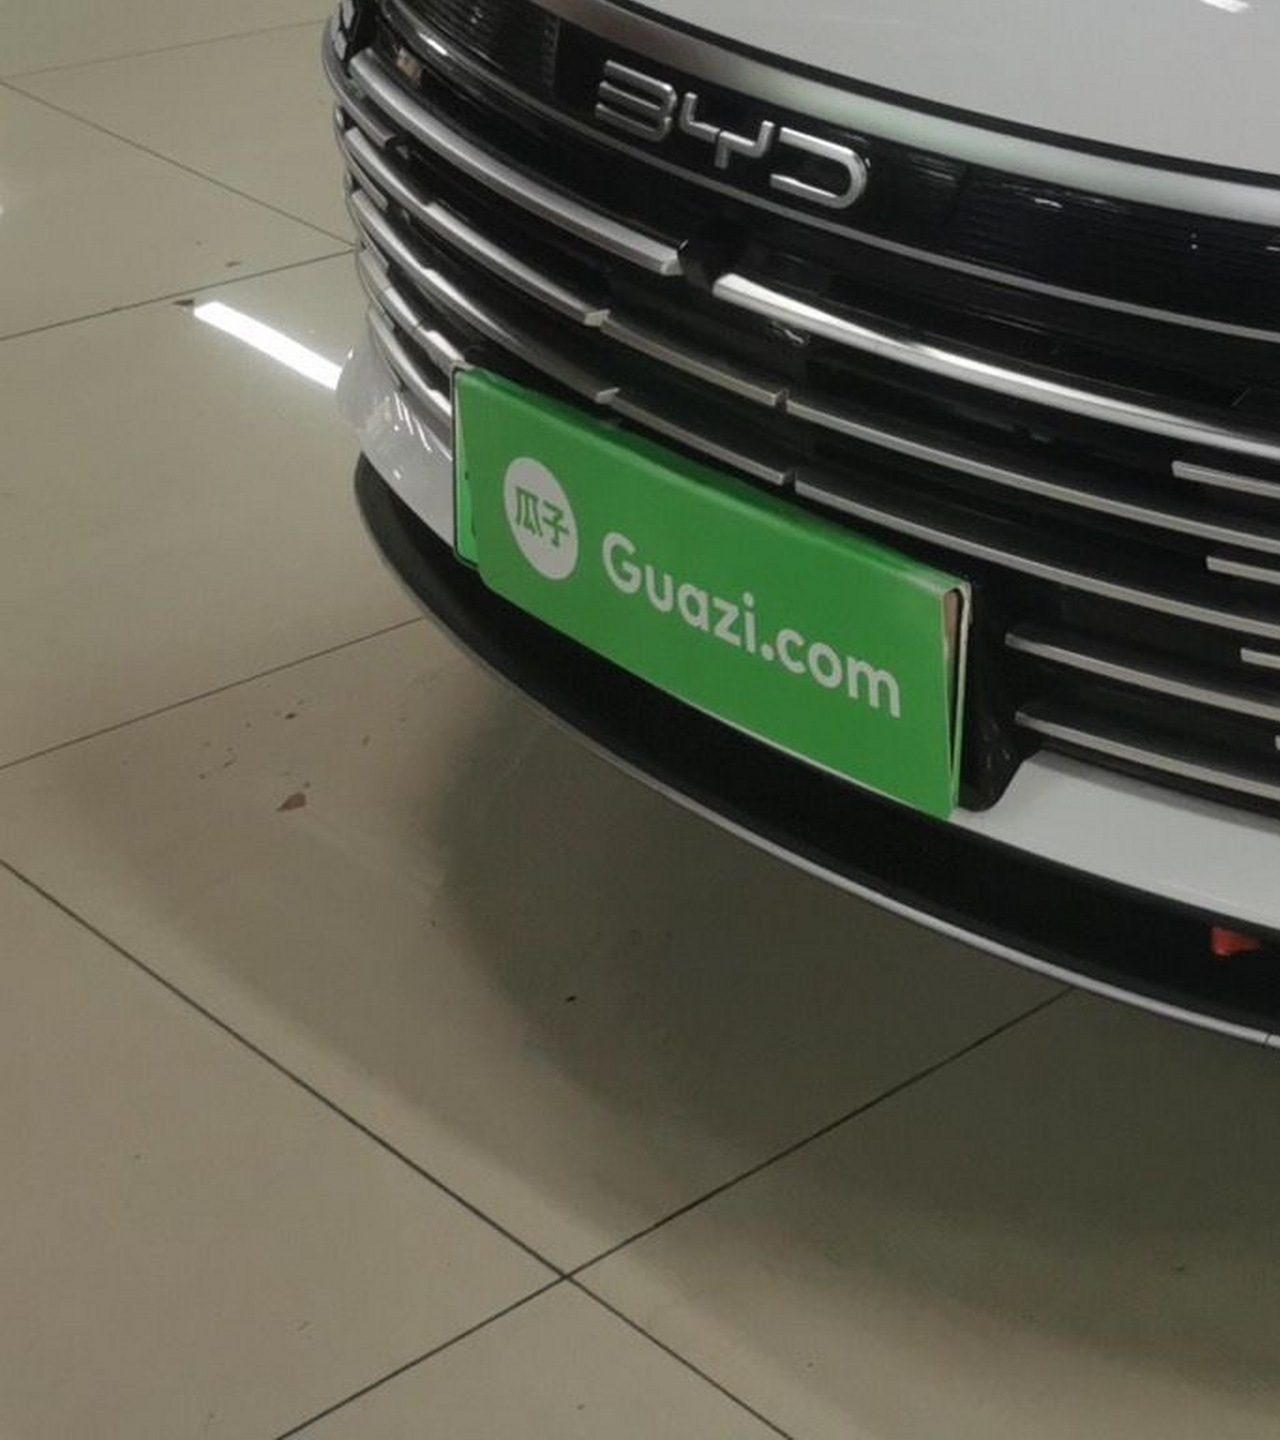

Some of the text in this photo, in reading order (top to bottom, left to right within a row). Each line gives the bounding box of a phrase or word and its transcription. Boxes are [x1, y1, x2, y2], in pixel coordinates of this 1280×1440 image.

[594, 59, 868, 210] BYD
[514, 487, 571, 549] 瓜子
[602, 531, 902, 719] Guazi.com
